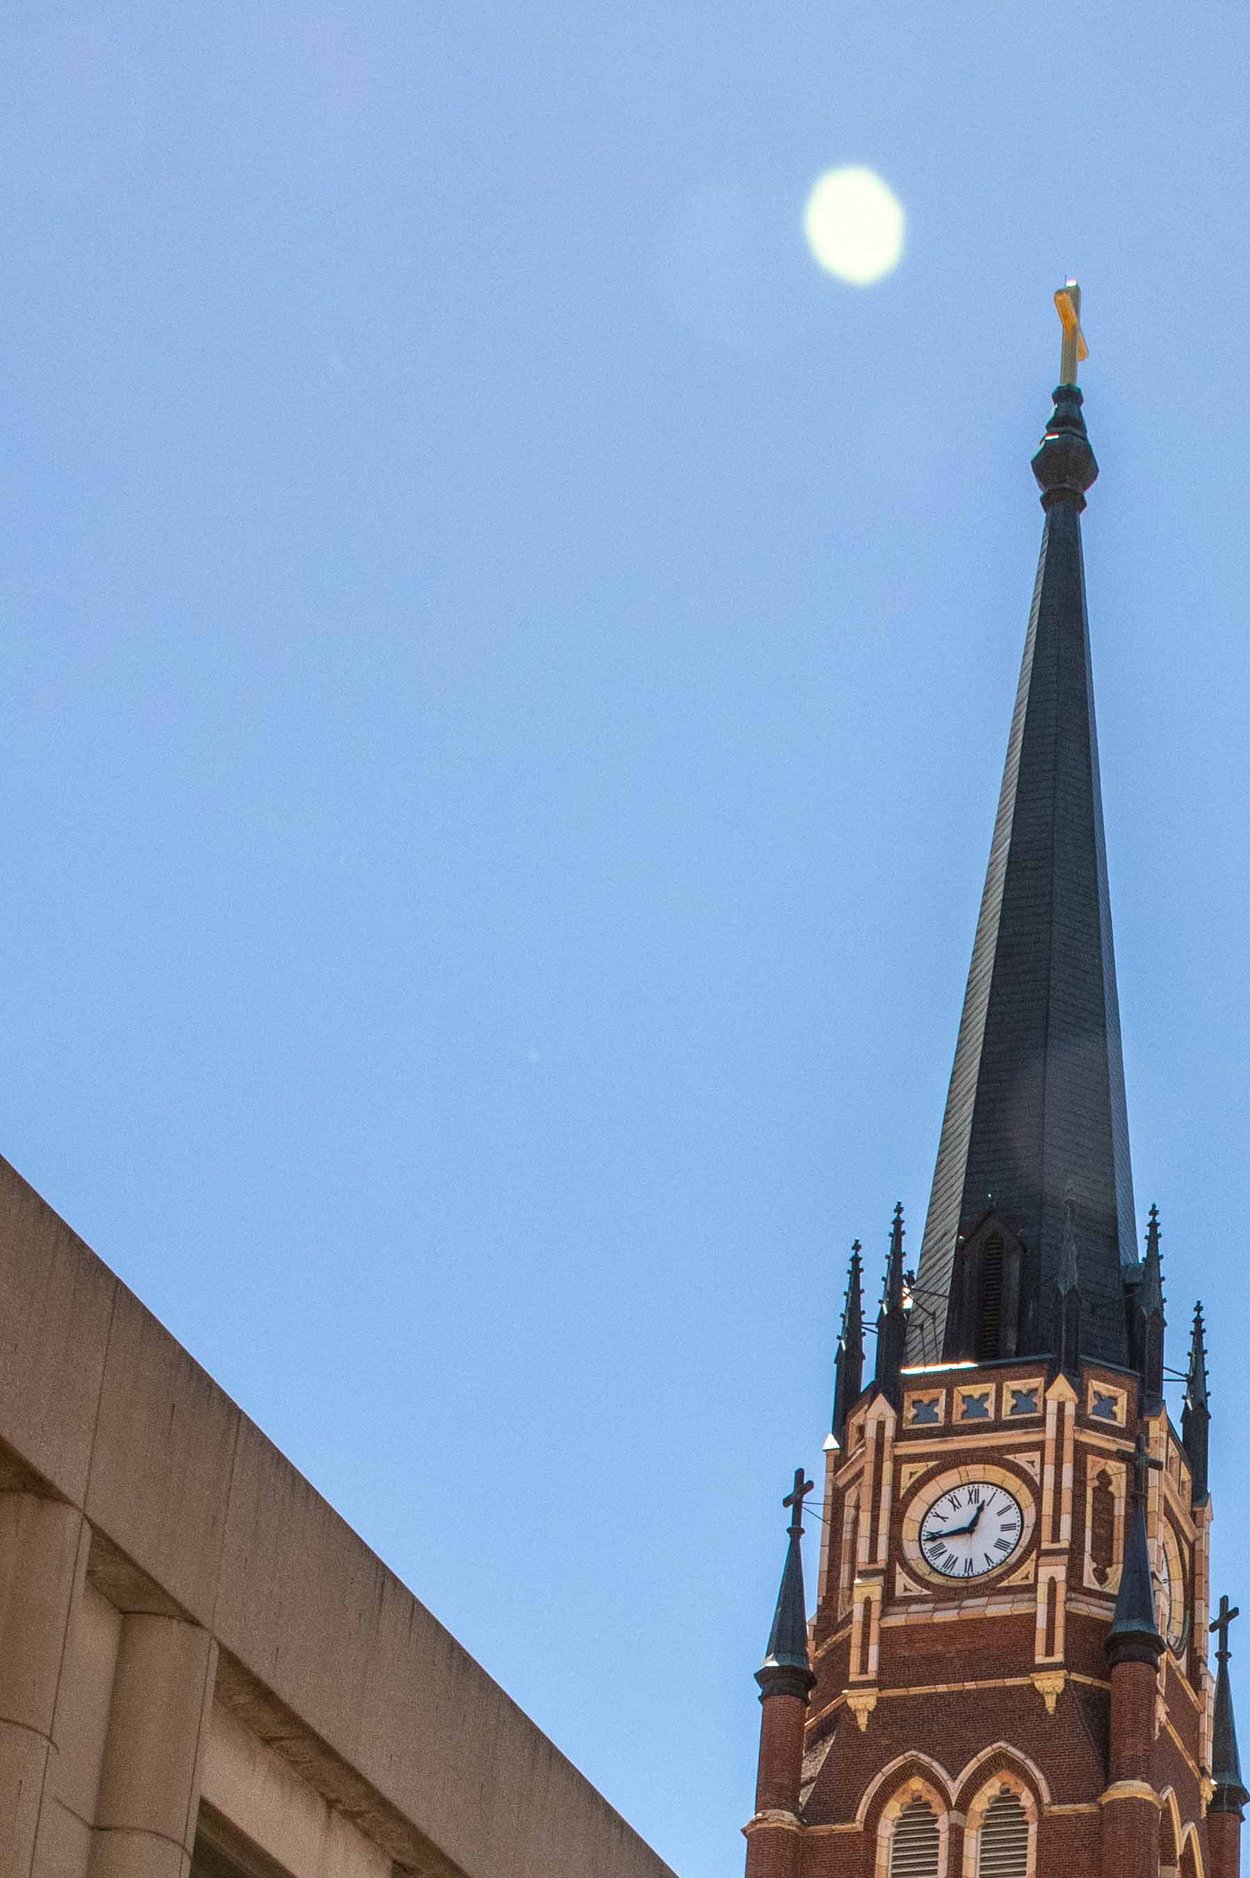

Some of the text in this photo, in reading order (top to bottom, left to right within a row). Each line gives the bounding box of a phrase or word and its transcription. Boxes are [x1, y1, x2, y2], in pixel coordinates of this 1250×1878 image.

[947, 1494, 962, 1512] XI
[967, 1487, 980, 1506] XII
[931, 1511, 949, 1523] X
[983, 1552, 995, 1567] V
